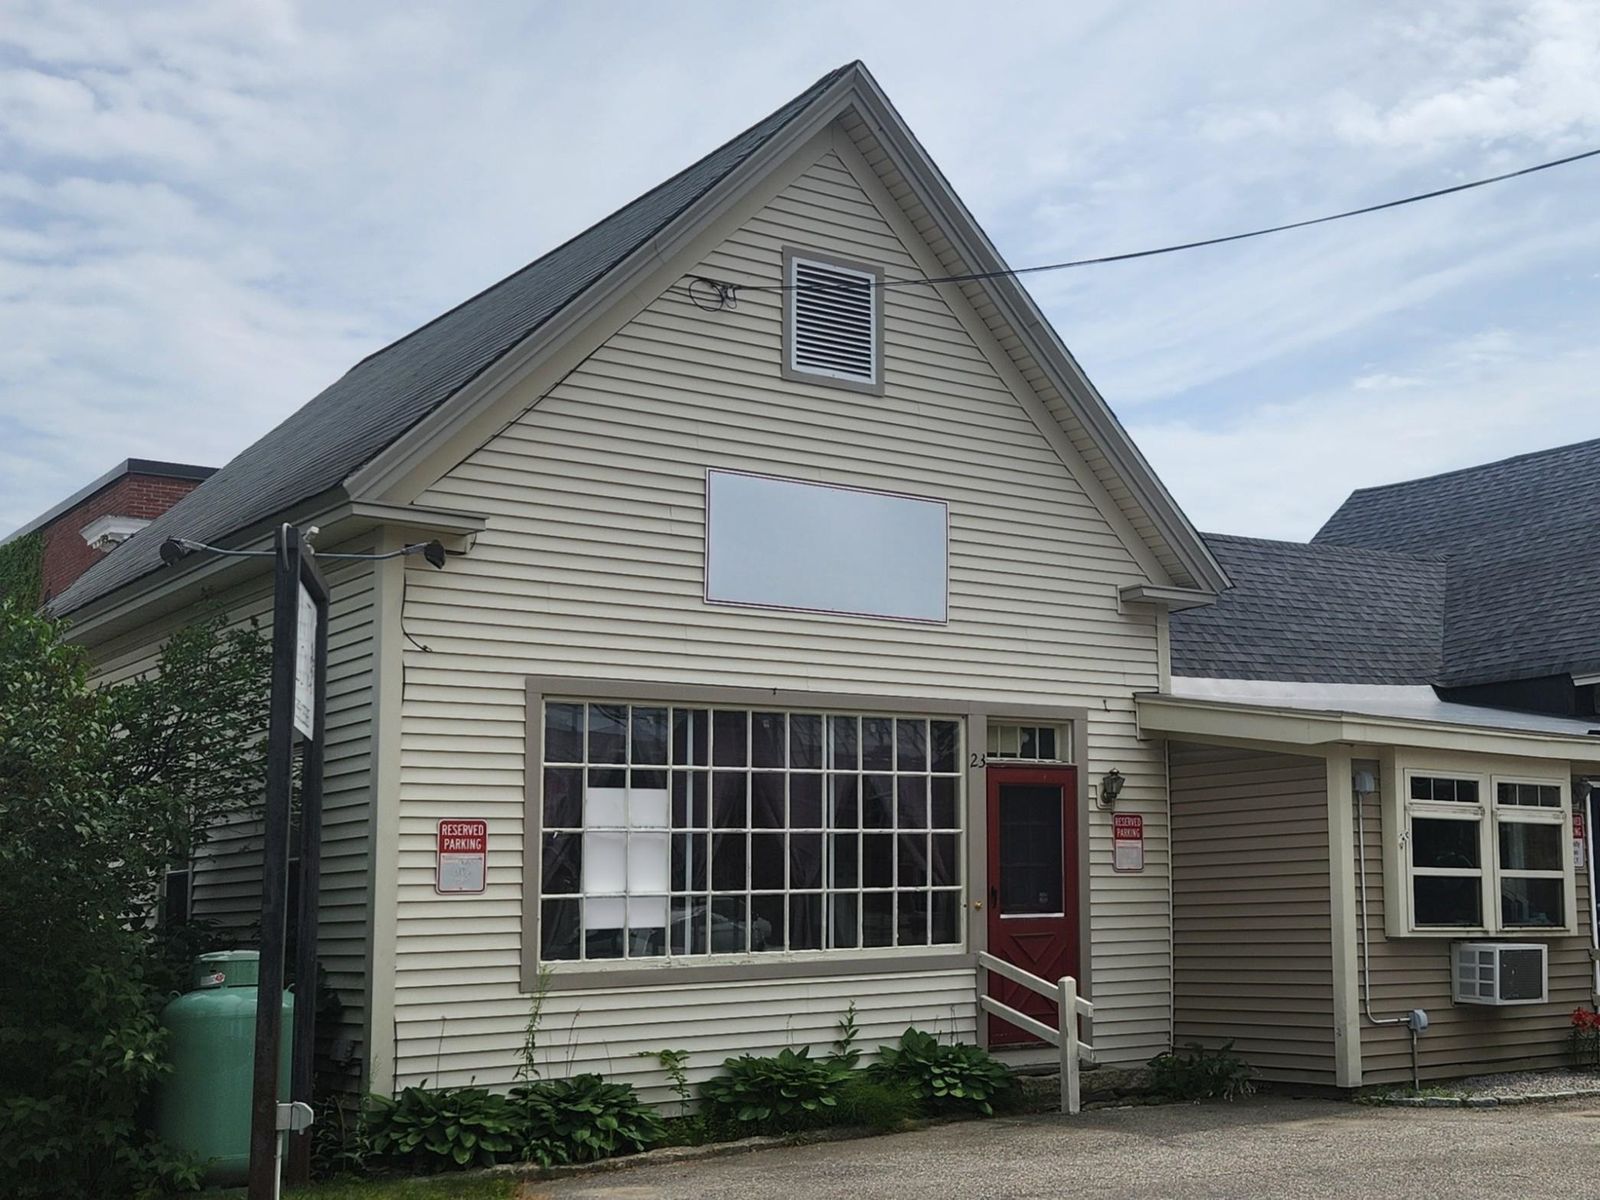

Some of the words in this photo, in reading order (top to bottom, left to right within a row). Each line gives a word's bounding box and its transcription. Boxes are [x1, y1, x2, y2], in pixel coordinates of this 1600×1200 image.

[970, 752, 986, 768] 23
[1115, 816, 1141, 827] RESERVED
[441, 823, 484, 836] RESERVED
[1116, 827, 1140, 838] PARKING
[444, 838, 482, 850] PARKING
